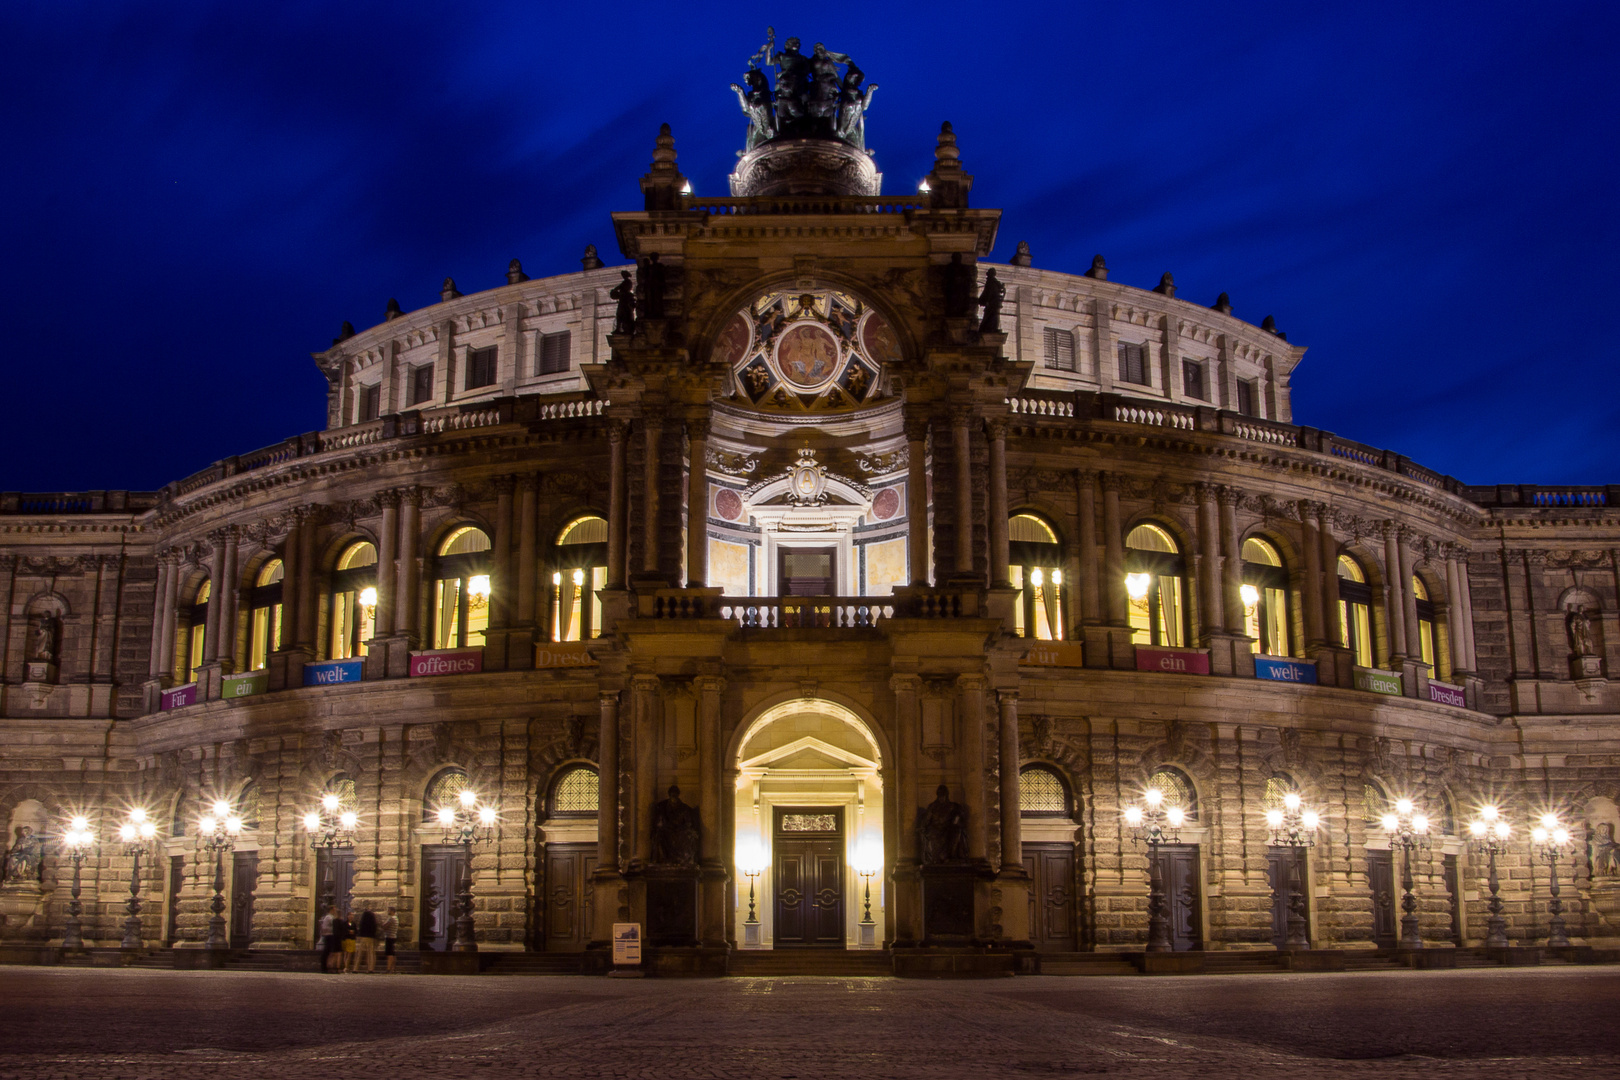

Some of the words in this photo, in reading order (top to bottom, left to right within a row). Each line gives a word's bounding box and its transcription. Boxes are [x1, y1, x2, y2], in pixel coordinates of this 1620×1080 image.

[417, 656, 475, 674] offenes
[538, 650, 595, 666] Dresd
[1160, 654, 1186, 671] ein
[316, 666, 348, 682] welt-
[1269, 664, 1303, 681] welt-
[236, 680, 252, 696] ein
[1359, 675, 1398, 694] offenes
[171, 691, 187, 708] Für
[1430, 686, 1465, 708] Dresden
